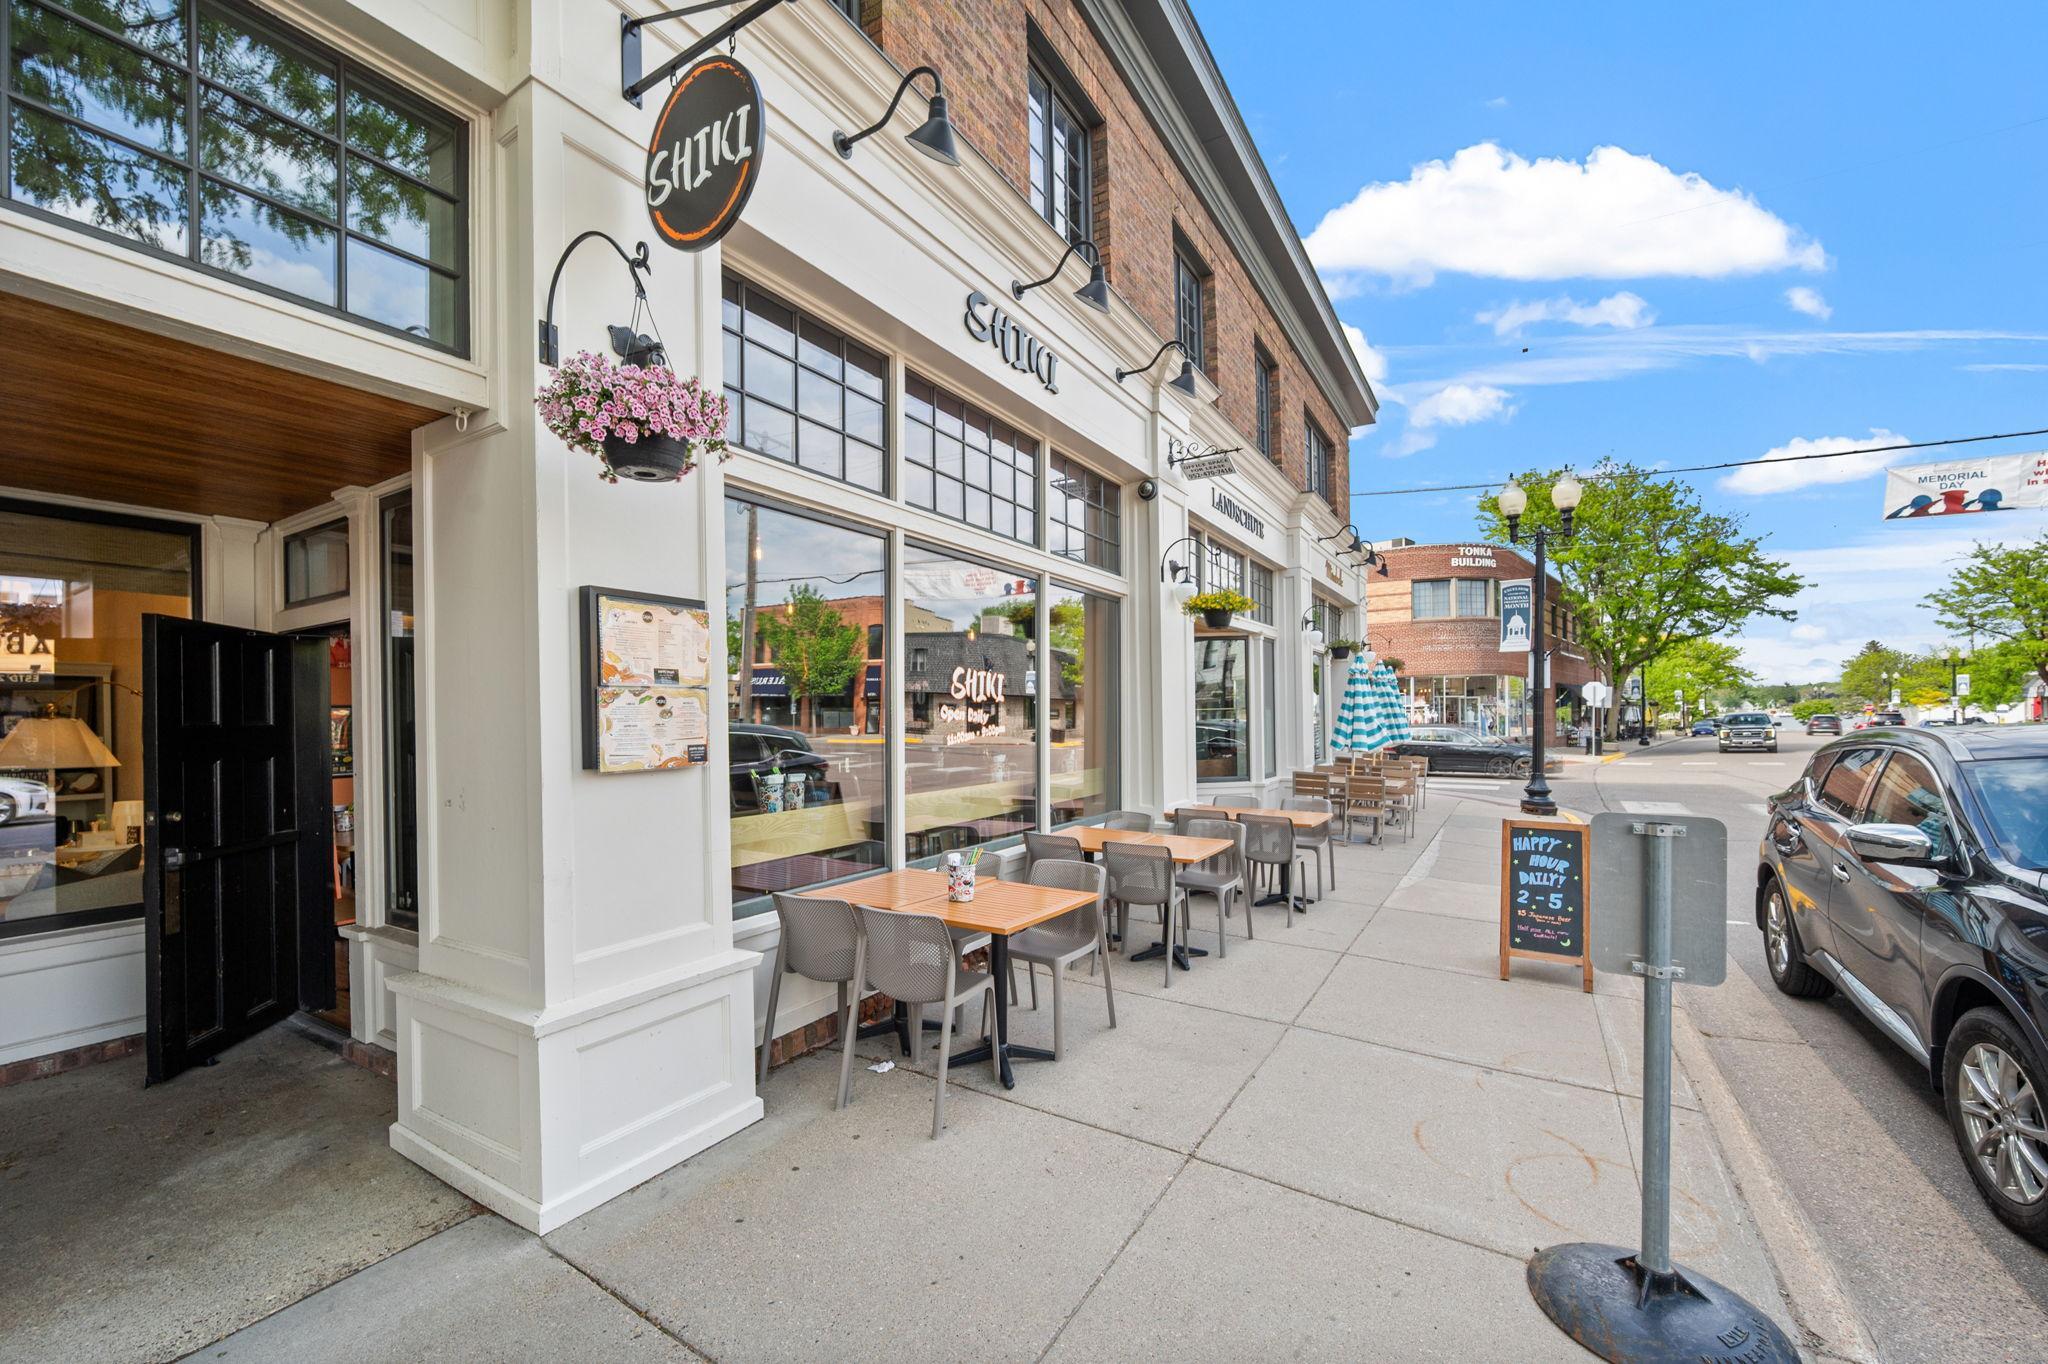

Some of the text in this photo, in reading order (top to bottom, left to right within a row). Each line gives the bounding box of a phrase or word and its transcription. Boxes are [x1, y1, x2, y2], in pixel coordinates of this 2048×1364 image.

[647, 104, 753, 206] SHIKI
[964, 291, 1060, 395] SHIKI
[1208, 458, 1229, 466] SPACE
[1918, 471, 1987, 484] MEMORIAL
[1939, 480, 1965, 490] DAY
[1211, 487, 1264, 540] LANDSCHUTE
[1458, 547, 1492, 557] TONKA
[1451, 557, 1497, 568] BUILDING
[951, 666, 1005, 702] SHIKI
[940, 704, 990, 725] Open Daily
[1513, 836, 1562, 853] HAPPY
[1529, 854, 1570, 874] HOUR
[1519, 871, 1567, 888] DAILY!
[1517, 889, 1530, 904] 2
[1548, 893, 1563, 909] 5
